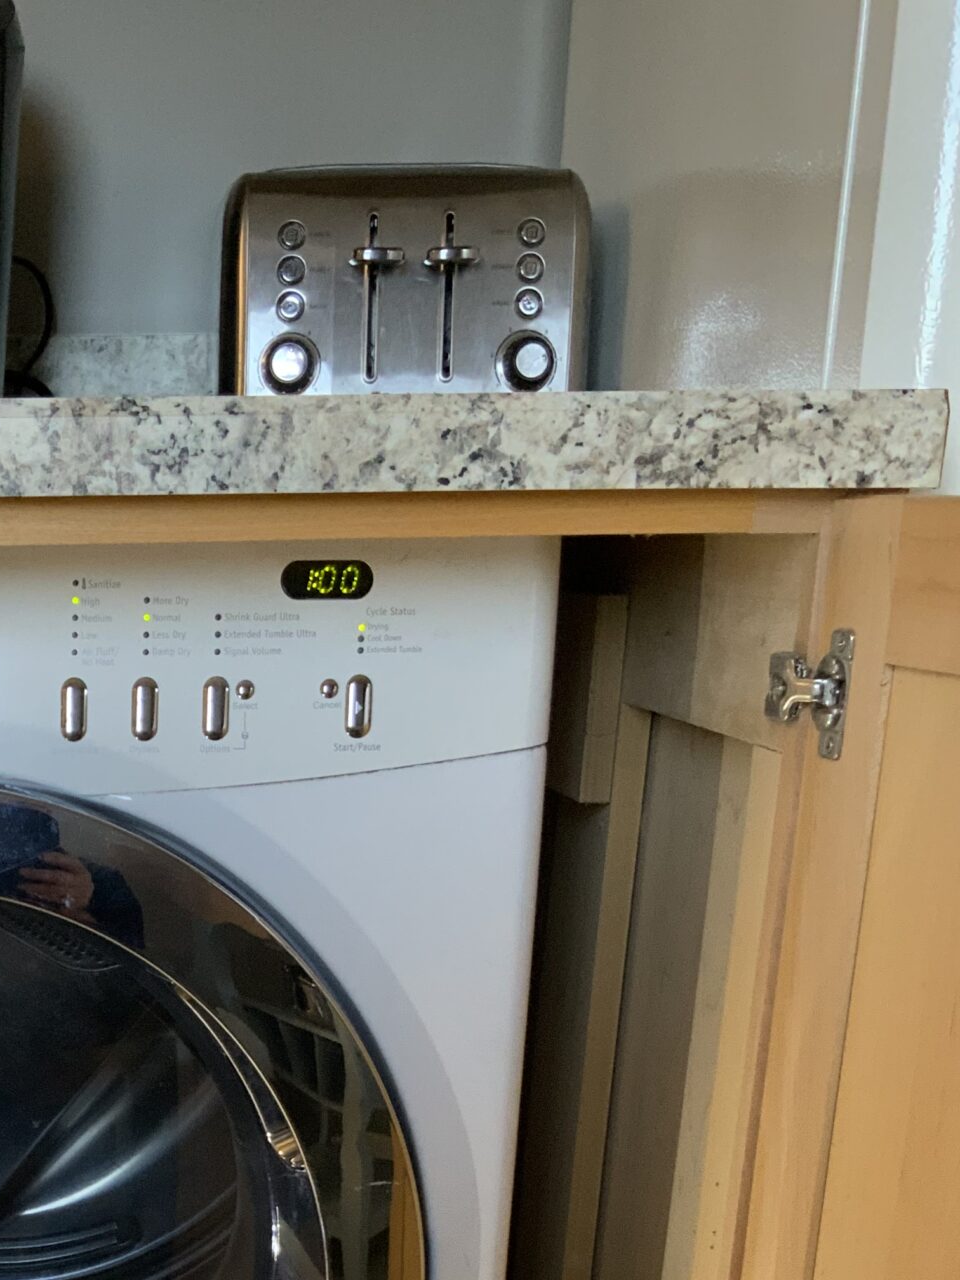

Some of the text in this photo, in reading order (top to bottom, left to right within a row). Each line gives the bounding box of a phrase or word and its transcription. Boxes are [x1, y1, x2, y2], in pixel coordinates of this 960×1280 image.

[88, 579, 121, 589] Sanitize
[176, 597, 189, 607] Dry
[224, 612, 300, 621] Shrink Guard Ultra
[366, 607, 416, 618] Cycle Status
[224, 629, 317, 639] Extended Tumble Ultra
[333, 742, 382, 753] Start/Pause
